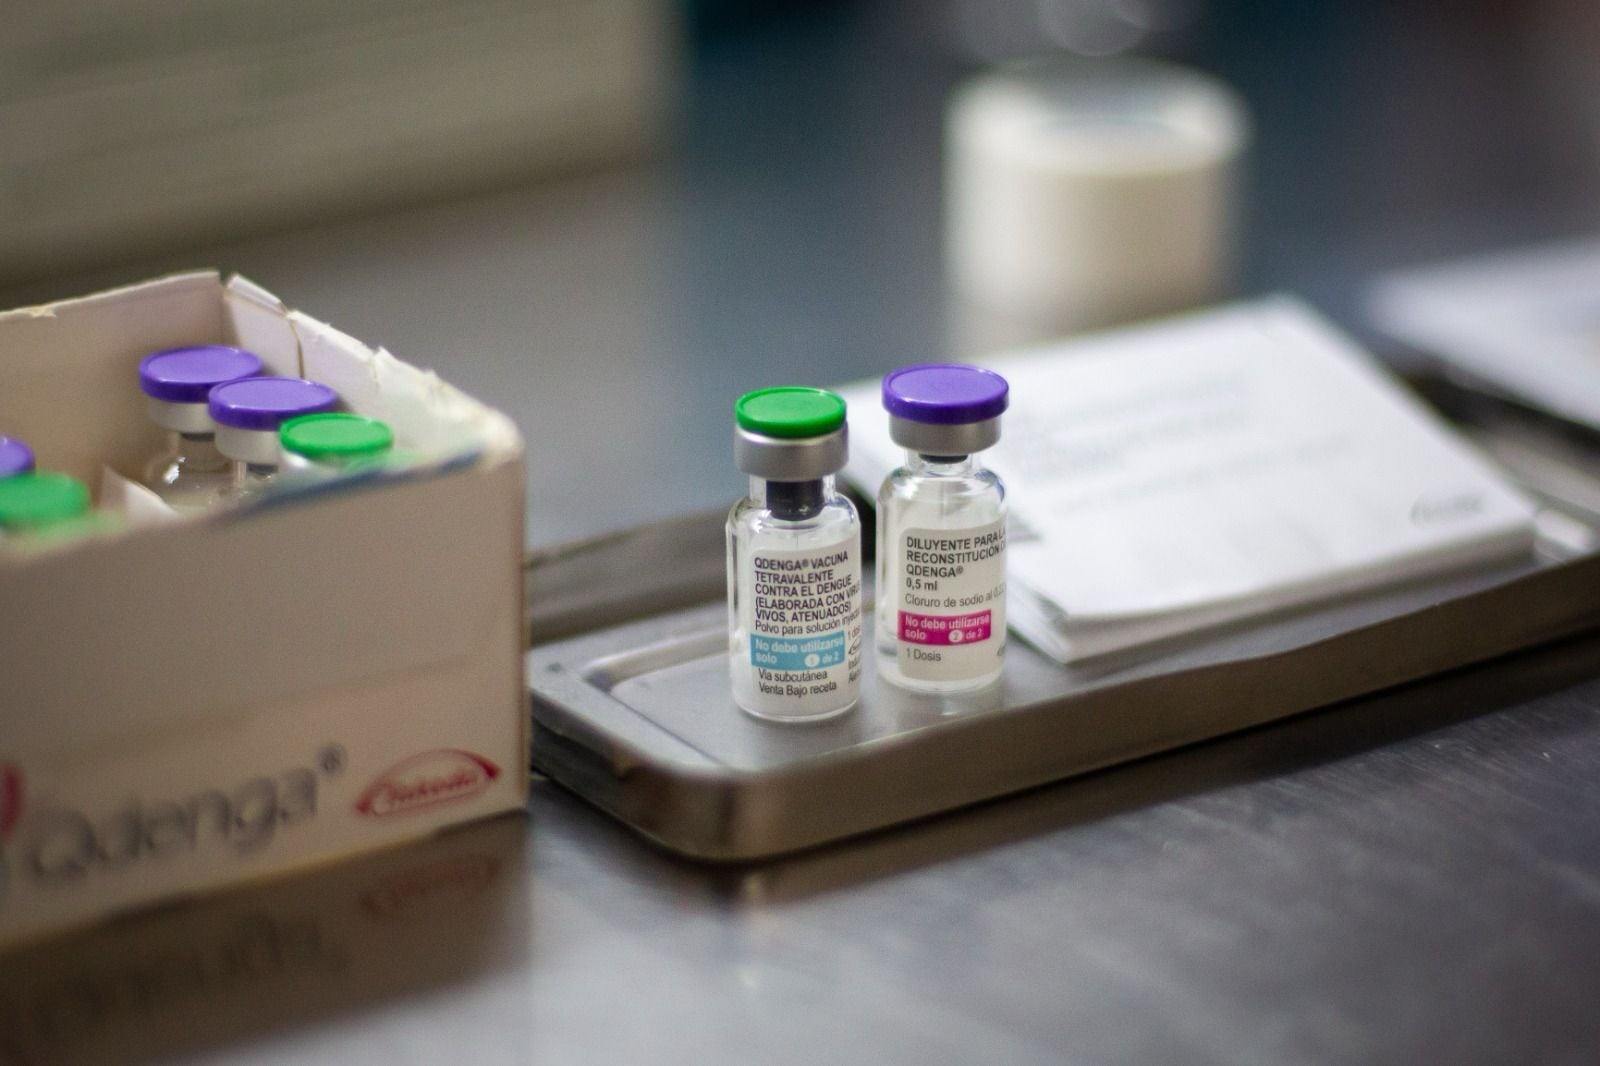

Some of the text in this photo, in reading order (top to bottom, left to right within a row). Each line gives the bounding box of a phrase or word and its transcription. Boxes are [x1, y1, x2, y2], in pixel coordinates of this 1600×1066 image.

[906, 537, 972, 551] DILUYENTE
[974, 531, 998, 548] PARA
[754, 550, 848, 571] QDENGA® VACUNA
[754, 570, 834, 585] TETRAVALENTE
[906, 564, 964, 578] QDENGA®
[755, 574, 852, 597] CONTRA EL DENGUE
[906, 577, 938, 591] 0,5 ml
[755, 596, 824, 611] (ELABORADA
[825, 592, 845, 606] CON
[905, 593, 941, 608] Cloruro
[943, 597, 957, 608] de
[959, 592, 985, 607] sodio
[755, 601, 852, 624] VIVOS, ATENUADOS)
[755, 620, 780, 634] Polvo
[782, 622, 803, 636] para
[806, 617, 840, 632] solución
[905, 614, 990, 630] No debe utilizarse
[904, 629, 927, 640] solo
[965, 630, 976, 640] de
[977, 628, 983, 638] 2
[755, 639, 770, 651] No
[771, 640, 798, 653] debe
[800, 636, 844, 653] utilizarse
[755, 652, 778, 664] solo
[913, 649, 942, 661] Dosis
[774, 671, 828, 682] subcutánea
[758, 680, 837, 698] Venta Bajo receta
